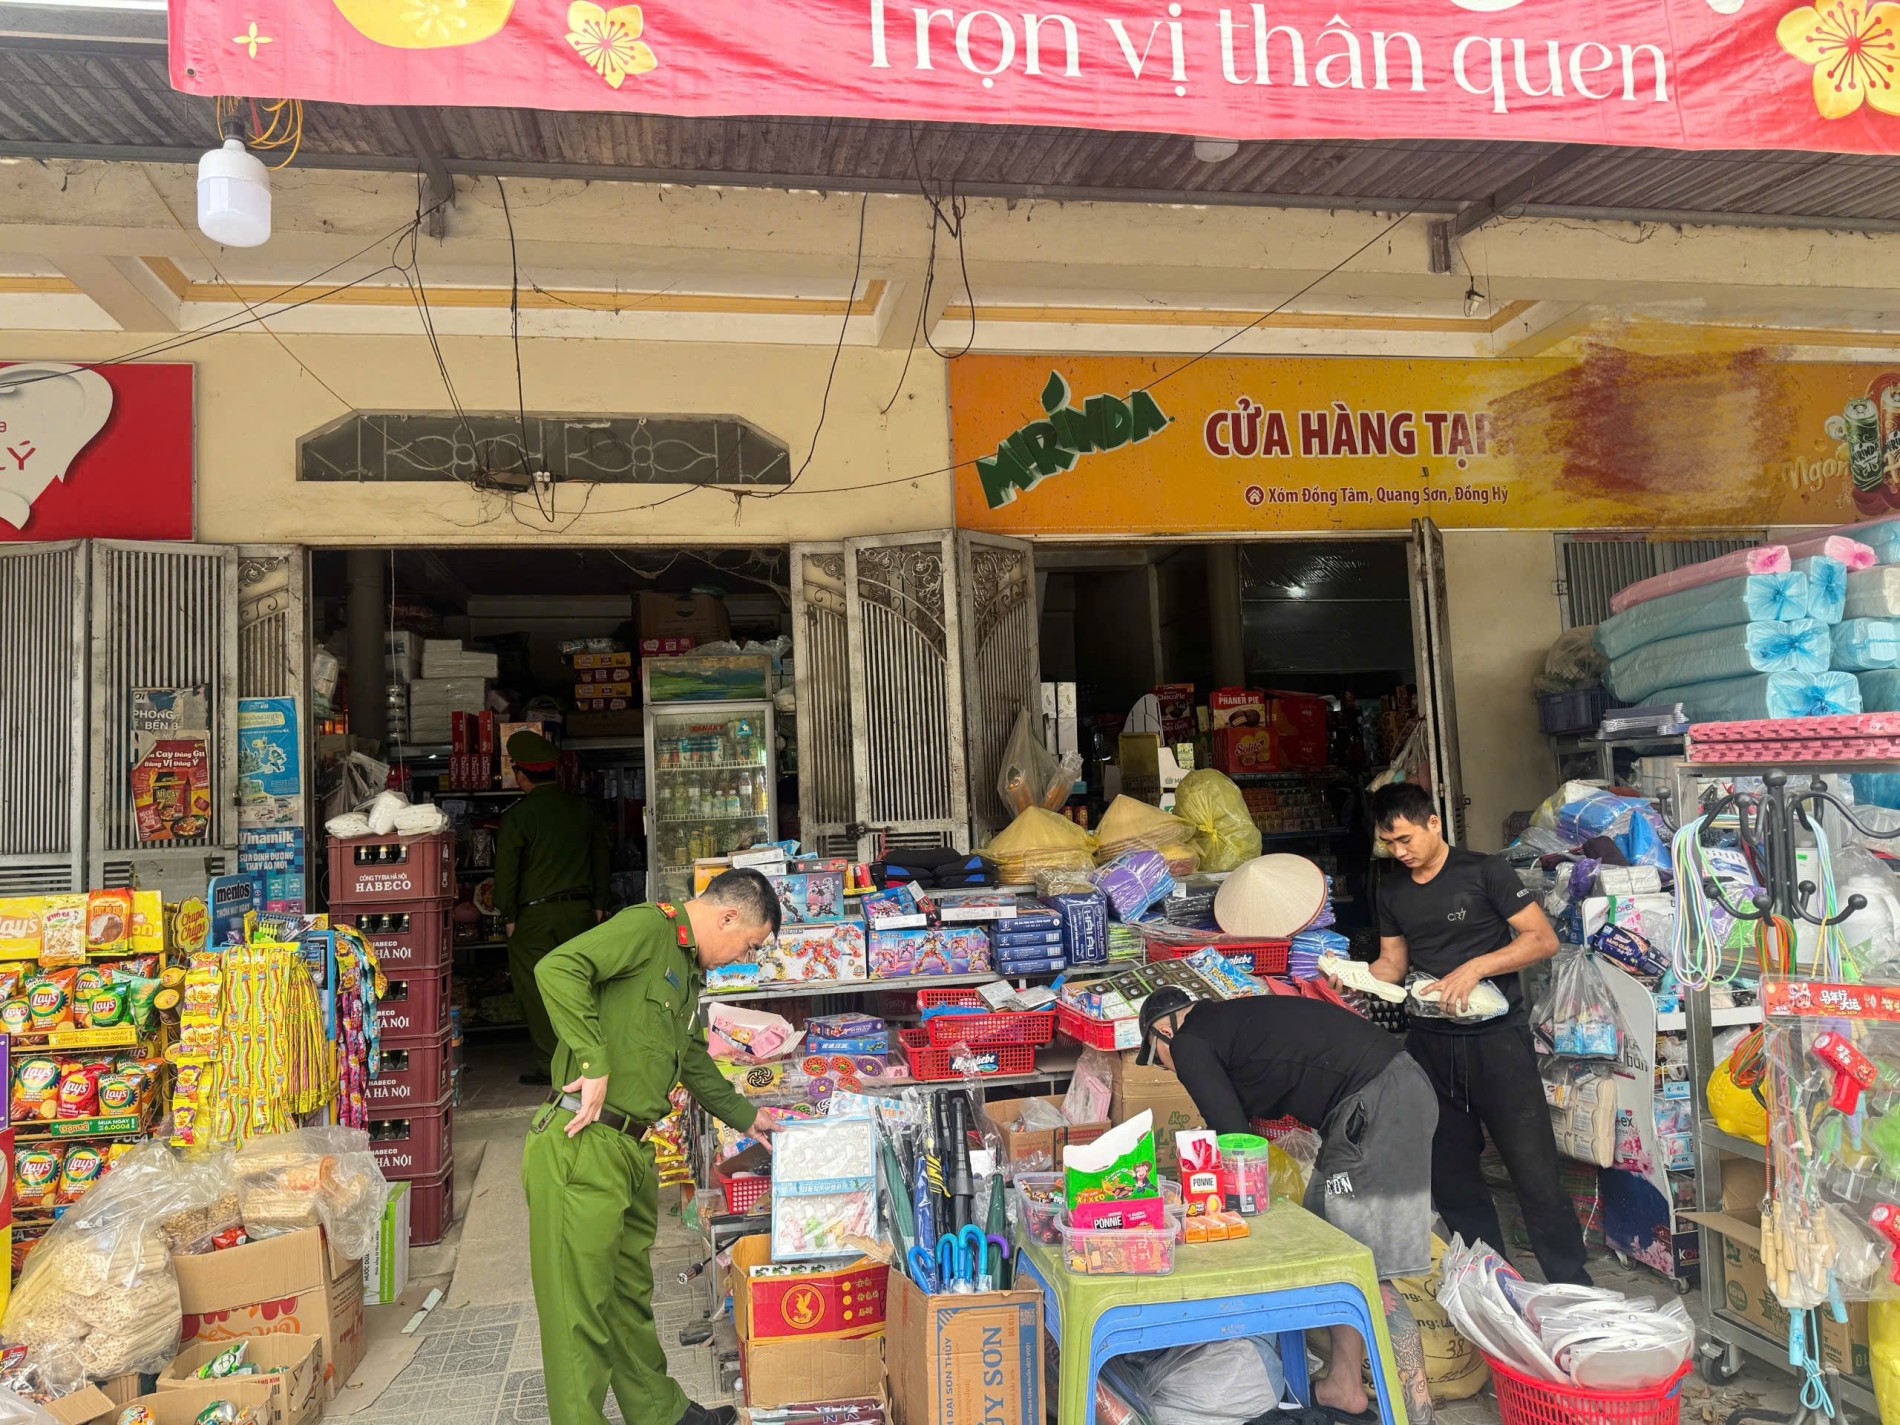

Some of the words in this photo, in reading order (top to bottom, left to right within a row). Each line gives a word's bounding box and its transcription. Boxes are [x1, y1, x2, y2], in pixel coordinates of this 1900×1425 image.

[1105, 3, 1187, 97] vị
[1216, 4, 1426, 92] thân
[1453, 36, 1669, 114] quen
[1204, 397, 1292, 456] CỬA
[1300, 402, 1417, 456] HÀNG
[975, 371, 1169, 510] MIRINDA
[1268, 487, 1299, 503] Xóm
[1301, 486, 1338, 506] Đồng
[1376, 487, 1420, 506] Quang
[1455, 486, 1491, 505] Đồng
[1218, 696, 1247, 705] PHANER
[1247, 696, 1260, 704] PIE
[239, 831, 294, 845] Vinamilk
[215, 882, 251, 904] mentos
[355, 880, 412, 893] HABECO
[181, 909, 205, 926] Chupa
[181, 923, 206, 942] Chups
[392, 946, 412, 960] NỘI
[32, 989, 60, 1008] Lay's
[91, 999, 117, 1014] Lay's
[390, 1016, 410, 1030] NỘI
[23, 1065, 54, 1083] Lay's
[62, 1081, 88, 1096] Lay's
[105, 1088, 128, 1102] Lay's
[374, 1085, 389, 1098] HÀ
[391, 1085, 411, 1098] NỘI
[22, 1160, 52, 1177] Lay's
[69, 1158, 97, 1173] Lay's
[392, 1154, 412, 1168] NỘI
[1192, 1176, 1214, 1188] PONNIE
[1093, 1216, 1123, 1230] PONNIE
[980, 1326, 1004, 1387] SƠN
[945, 1370, 953, 1395] SƠN
